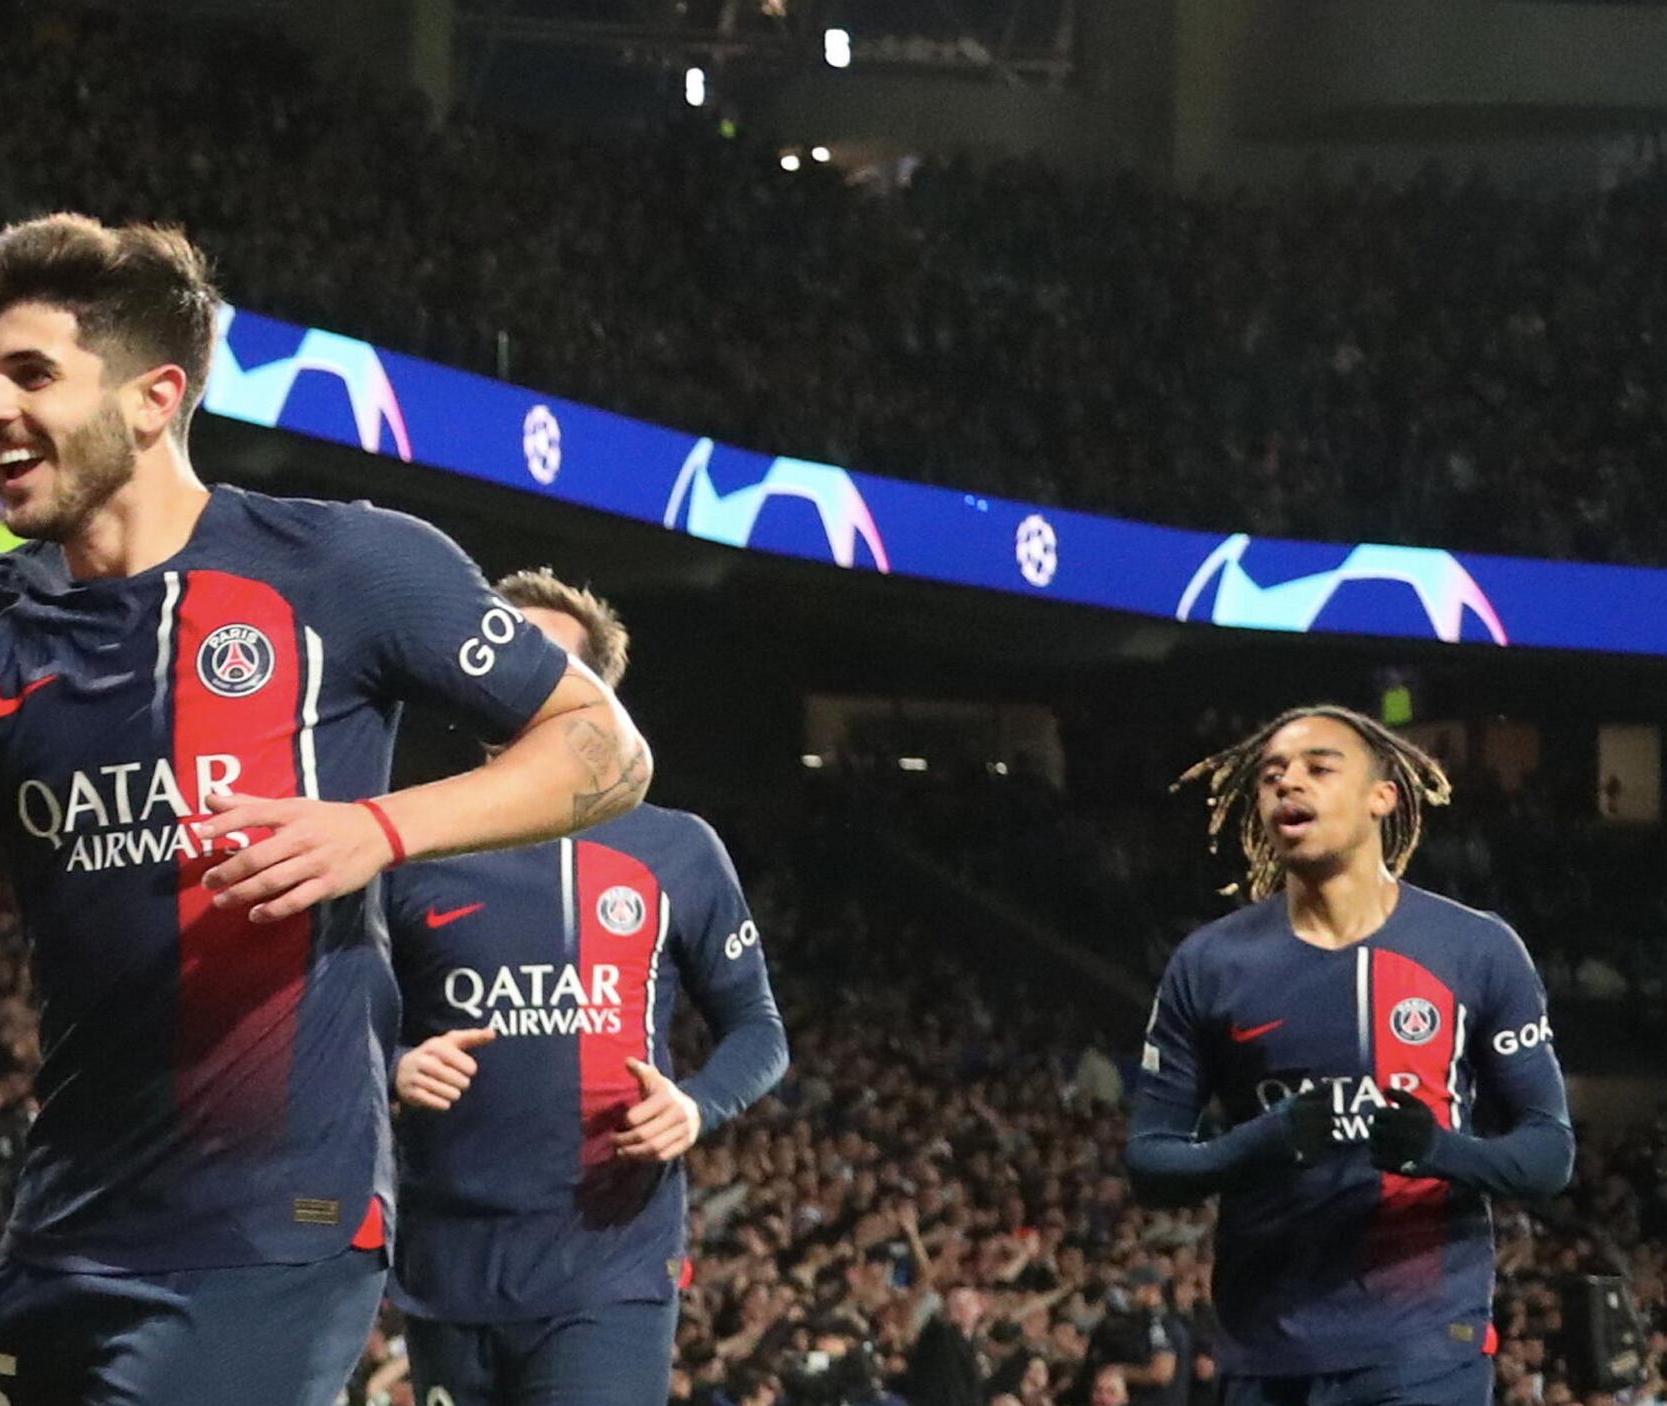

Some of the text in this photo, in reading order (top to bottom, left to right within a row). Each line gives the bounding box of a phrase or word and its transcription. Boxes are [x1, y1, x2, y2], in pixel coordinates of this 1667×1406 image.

[208, 628, 259, 649] PARIS
[18, 753, 242, 851] QATAR
[444, 963, 622, 1018] QATAR
[487, 1009, 622, 1037] AIRWAYS
